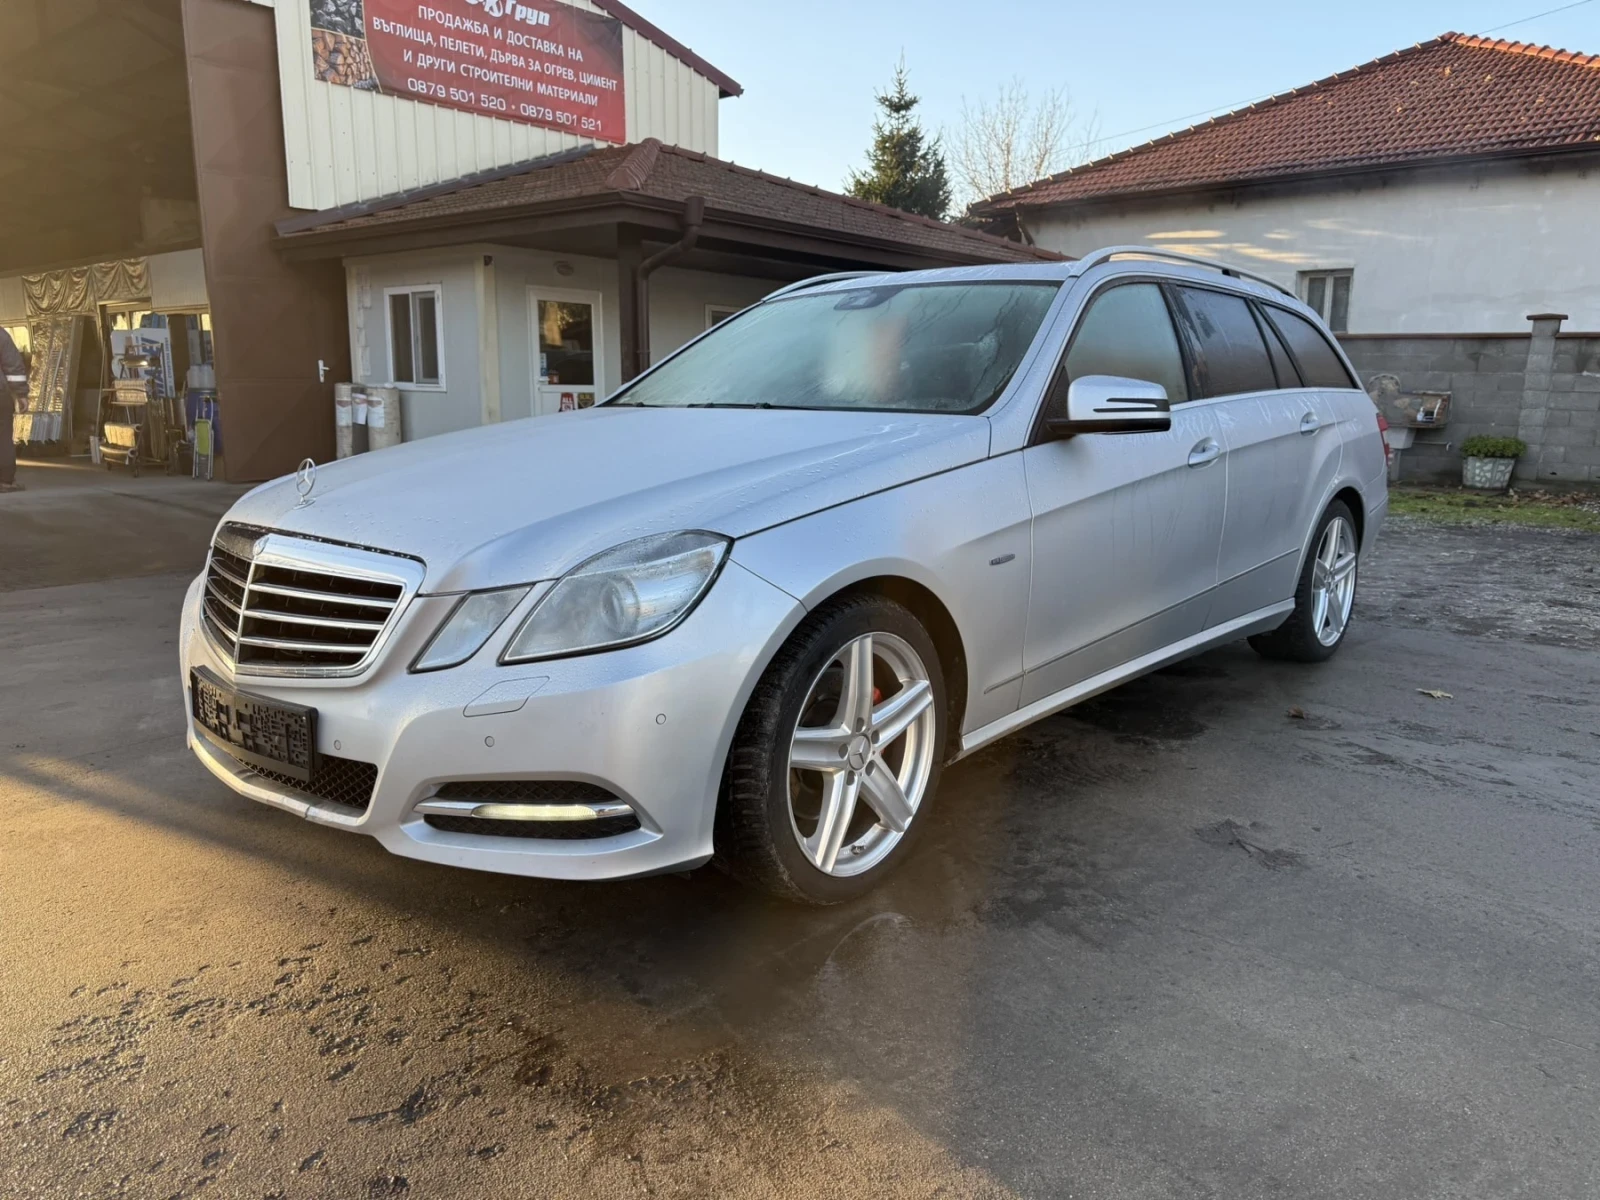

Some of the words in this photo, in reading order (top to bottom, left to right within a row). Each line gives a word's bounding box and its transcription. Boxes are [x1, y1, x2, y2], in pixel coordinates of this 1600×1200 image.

[418, 5, 490, 37] ПРОДАЖБА
[493, 26, 503, 40] И
[506, 30, 565, 57] ДОСТАВКА
[567, 47, 583, 62] НА
[505, 0, 550, 26] Груп
[373, 16, 437, 48] ВЪГЛИЩА,
[439, 35, 488, 59] ПЕЛЕТИ,
[489, 48, 526, 68] ДЪРВА
[528, 58, 542, 72] ЗА
[543, 62, 577, 82] ОГРЕВ,
[579, 71, 618, 91] ЦИМЕНТ
[403, 49, 413, 63] И
[417, 52, 456, 74] ДРУГИ
[460, 63, 533, 92] СТРОИТЕЛНИ
[537, 82, 598, 107] МАТЕРИАЛИ
[407, 77, 446, 98] 0879
[449, 87, 475, 105] 501
[480, 94, 506, 111] 520
[520, 103, 553, 121] 0879
[555, 110, 577, 126] 501
[581, 116, 602, 131] 521
